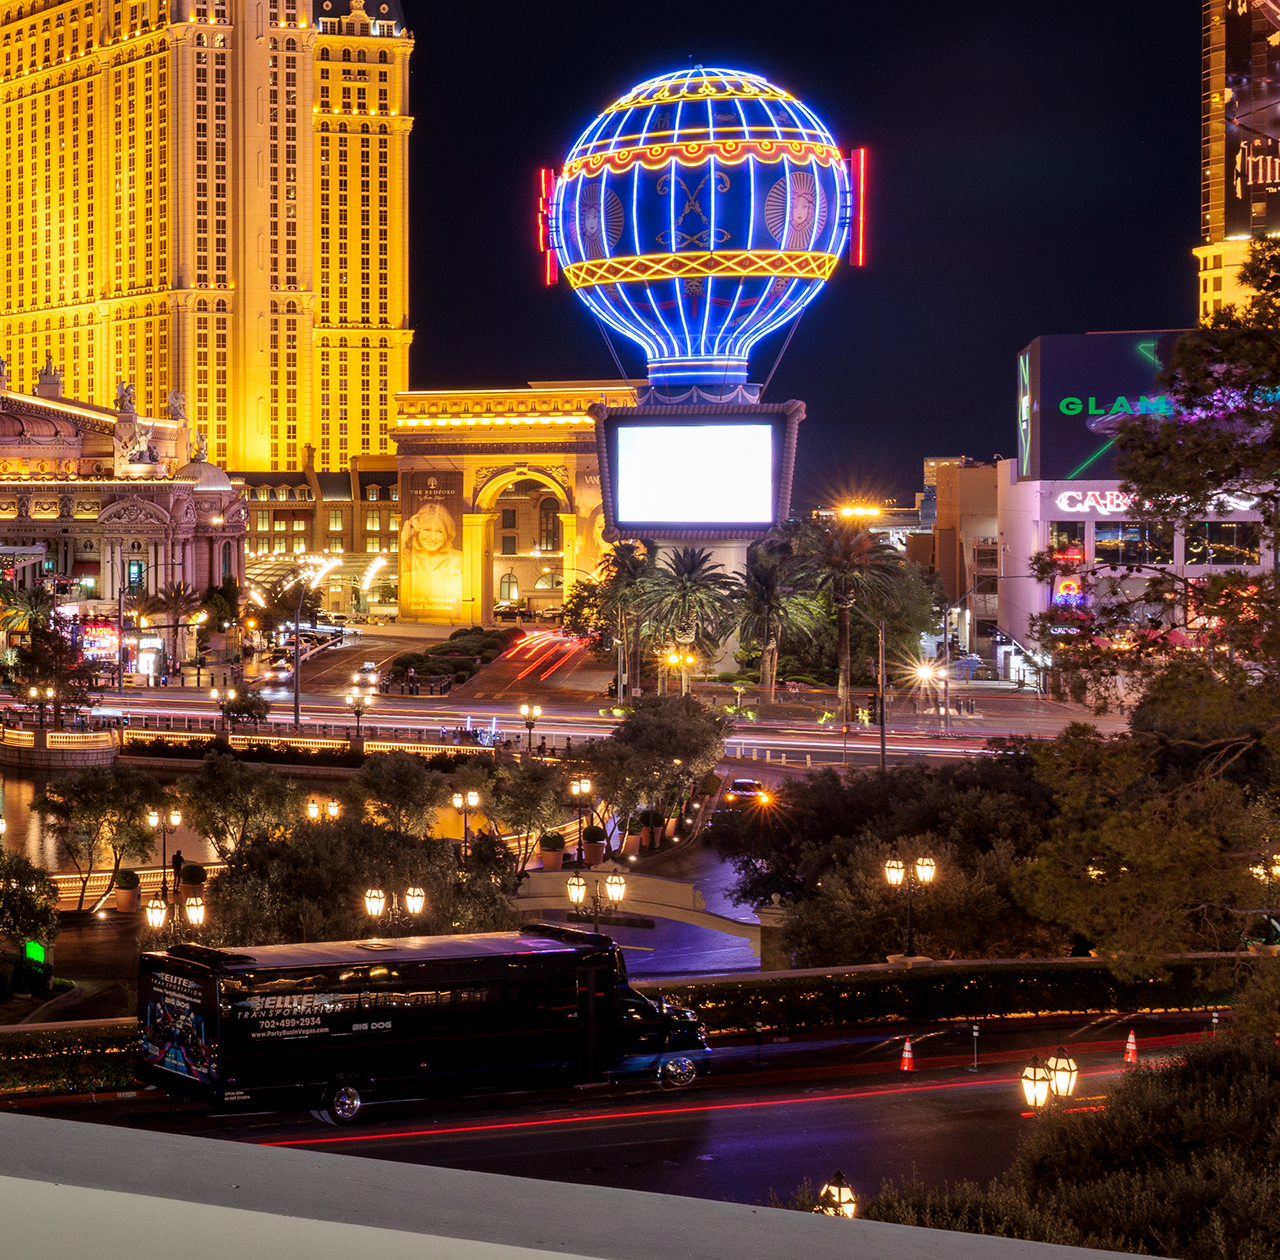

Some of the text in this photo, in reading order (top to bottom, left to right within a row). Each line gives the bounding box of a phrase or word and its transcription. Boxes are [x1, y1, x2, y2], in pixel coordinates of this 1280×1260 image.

[264, 993, 316, 1009] ELITE
[237, 1006, 342, 1020] TRANSPORTATION
[352, 1021, 392, 1031] BIG DOG
